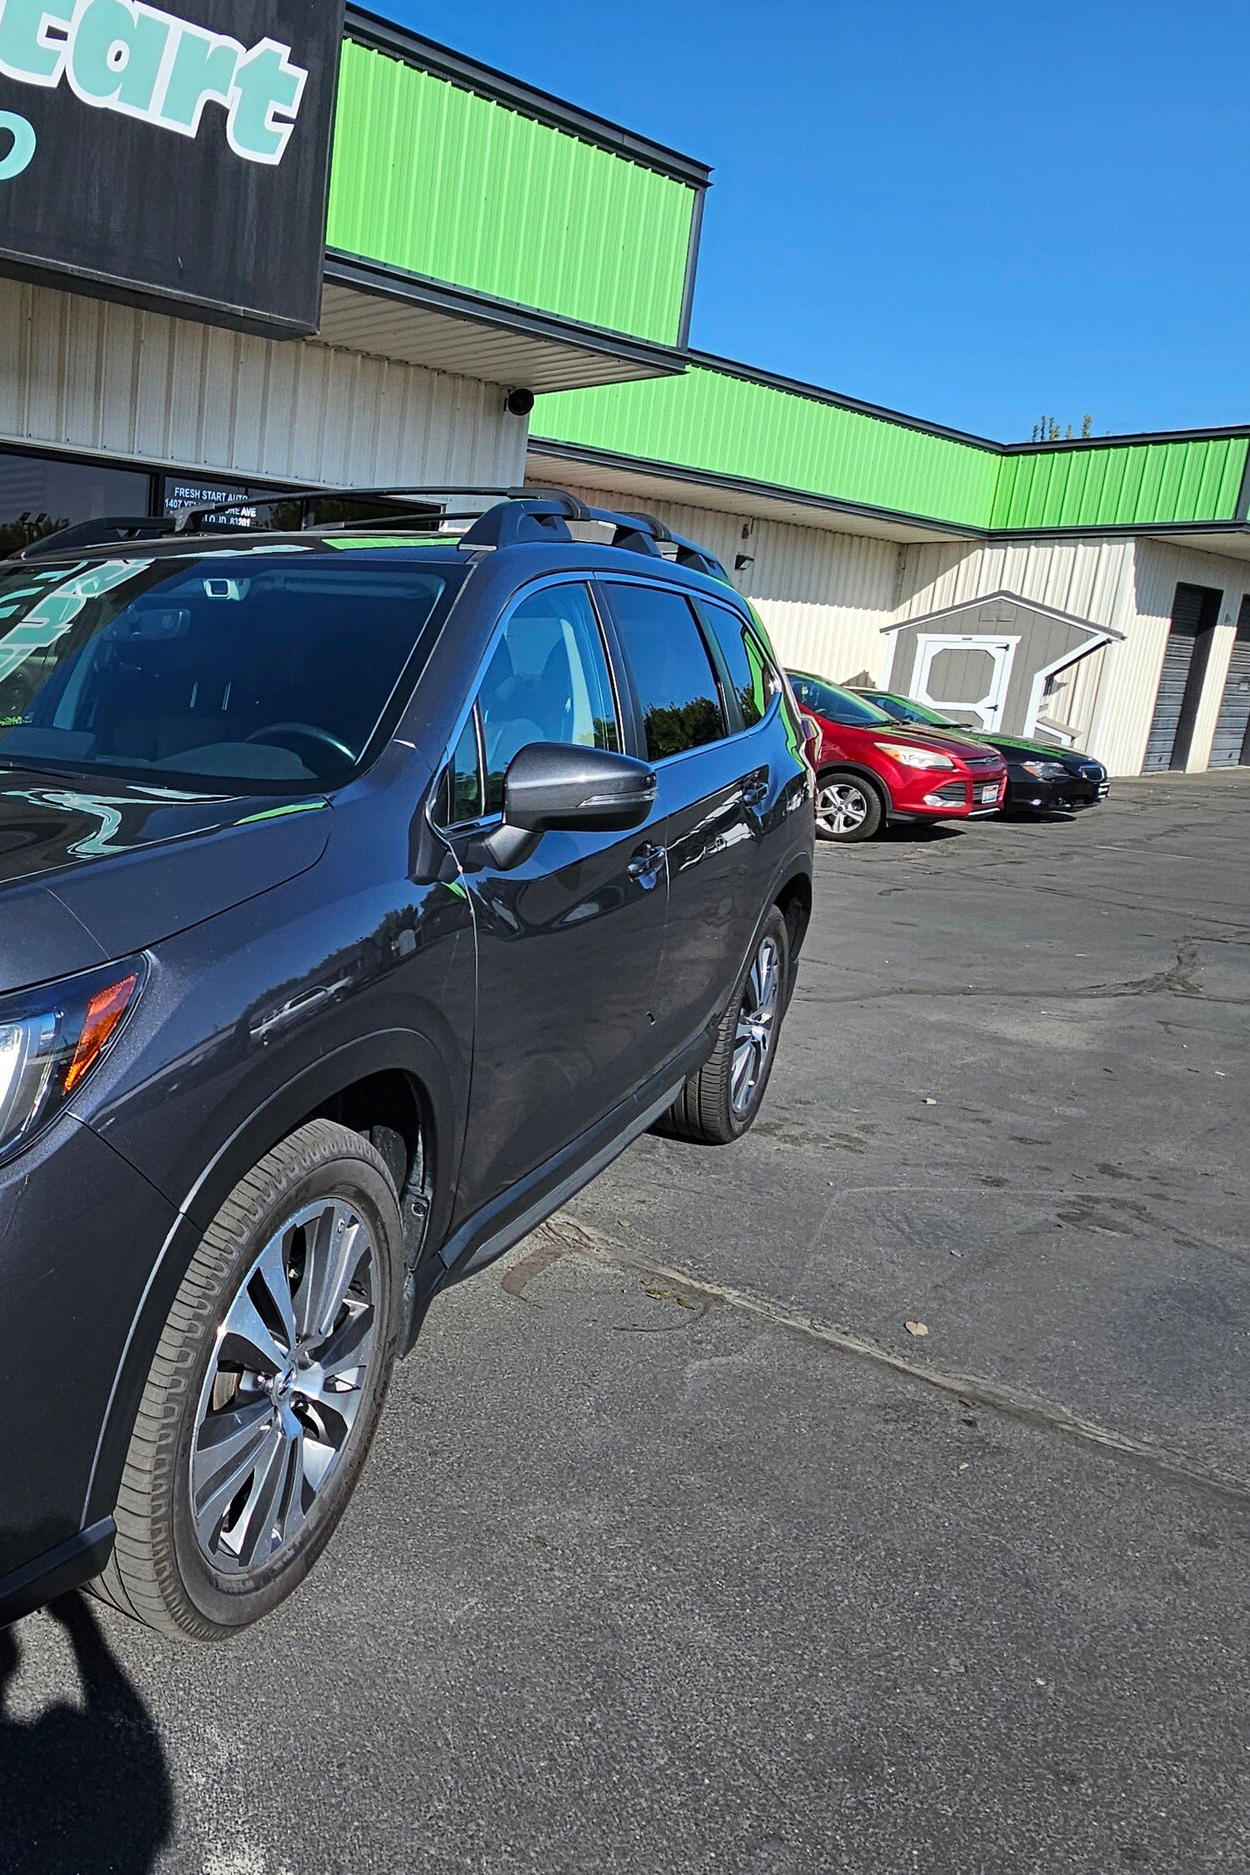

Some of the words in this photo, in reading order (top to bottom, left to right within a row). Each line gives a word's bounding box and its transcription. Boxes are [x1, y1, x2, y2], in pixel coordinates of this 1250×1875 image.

[174, 487, 200, 499] FRESH
[202, 490, 226, 502] START
[164, 498, 182, 508] 1407
[240, 506, 256, 517] AVE
